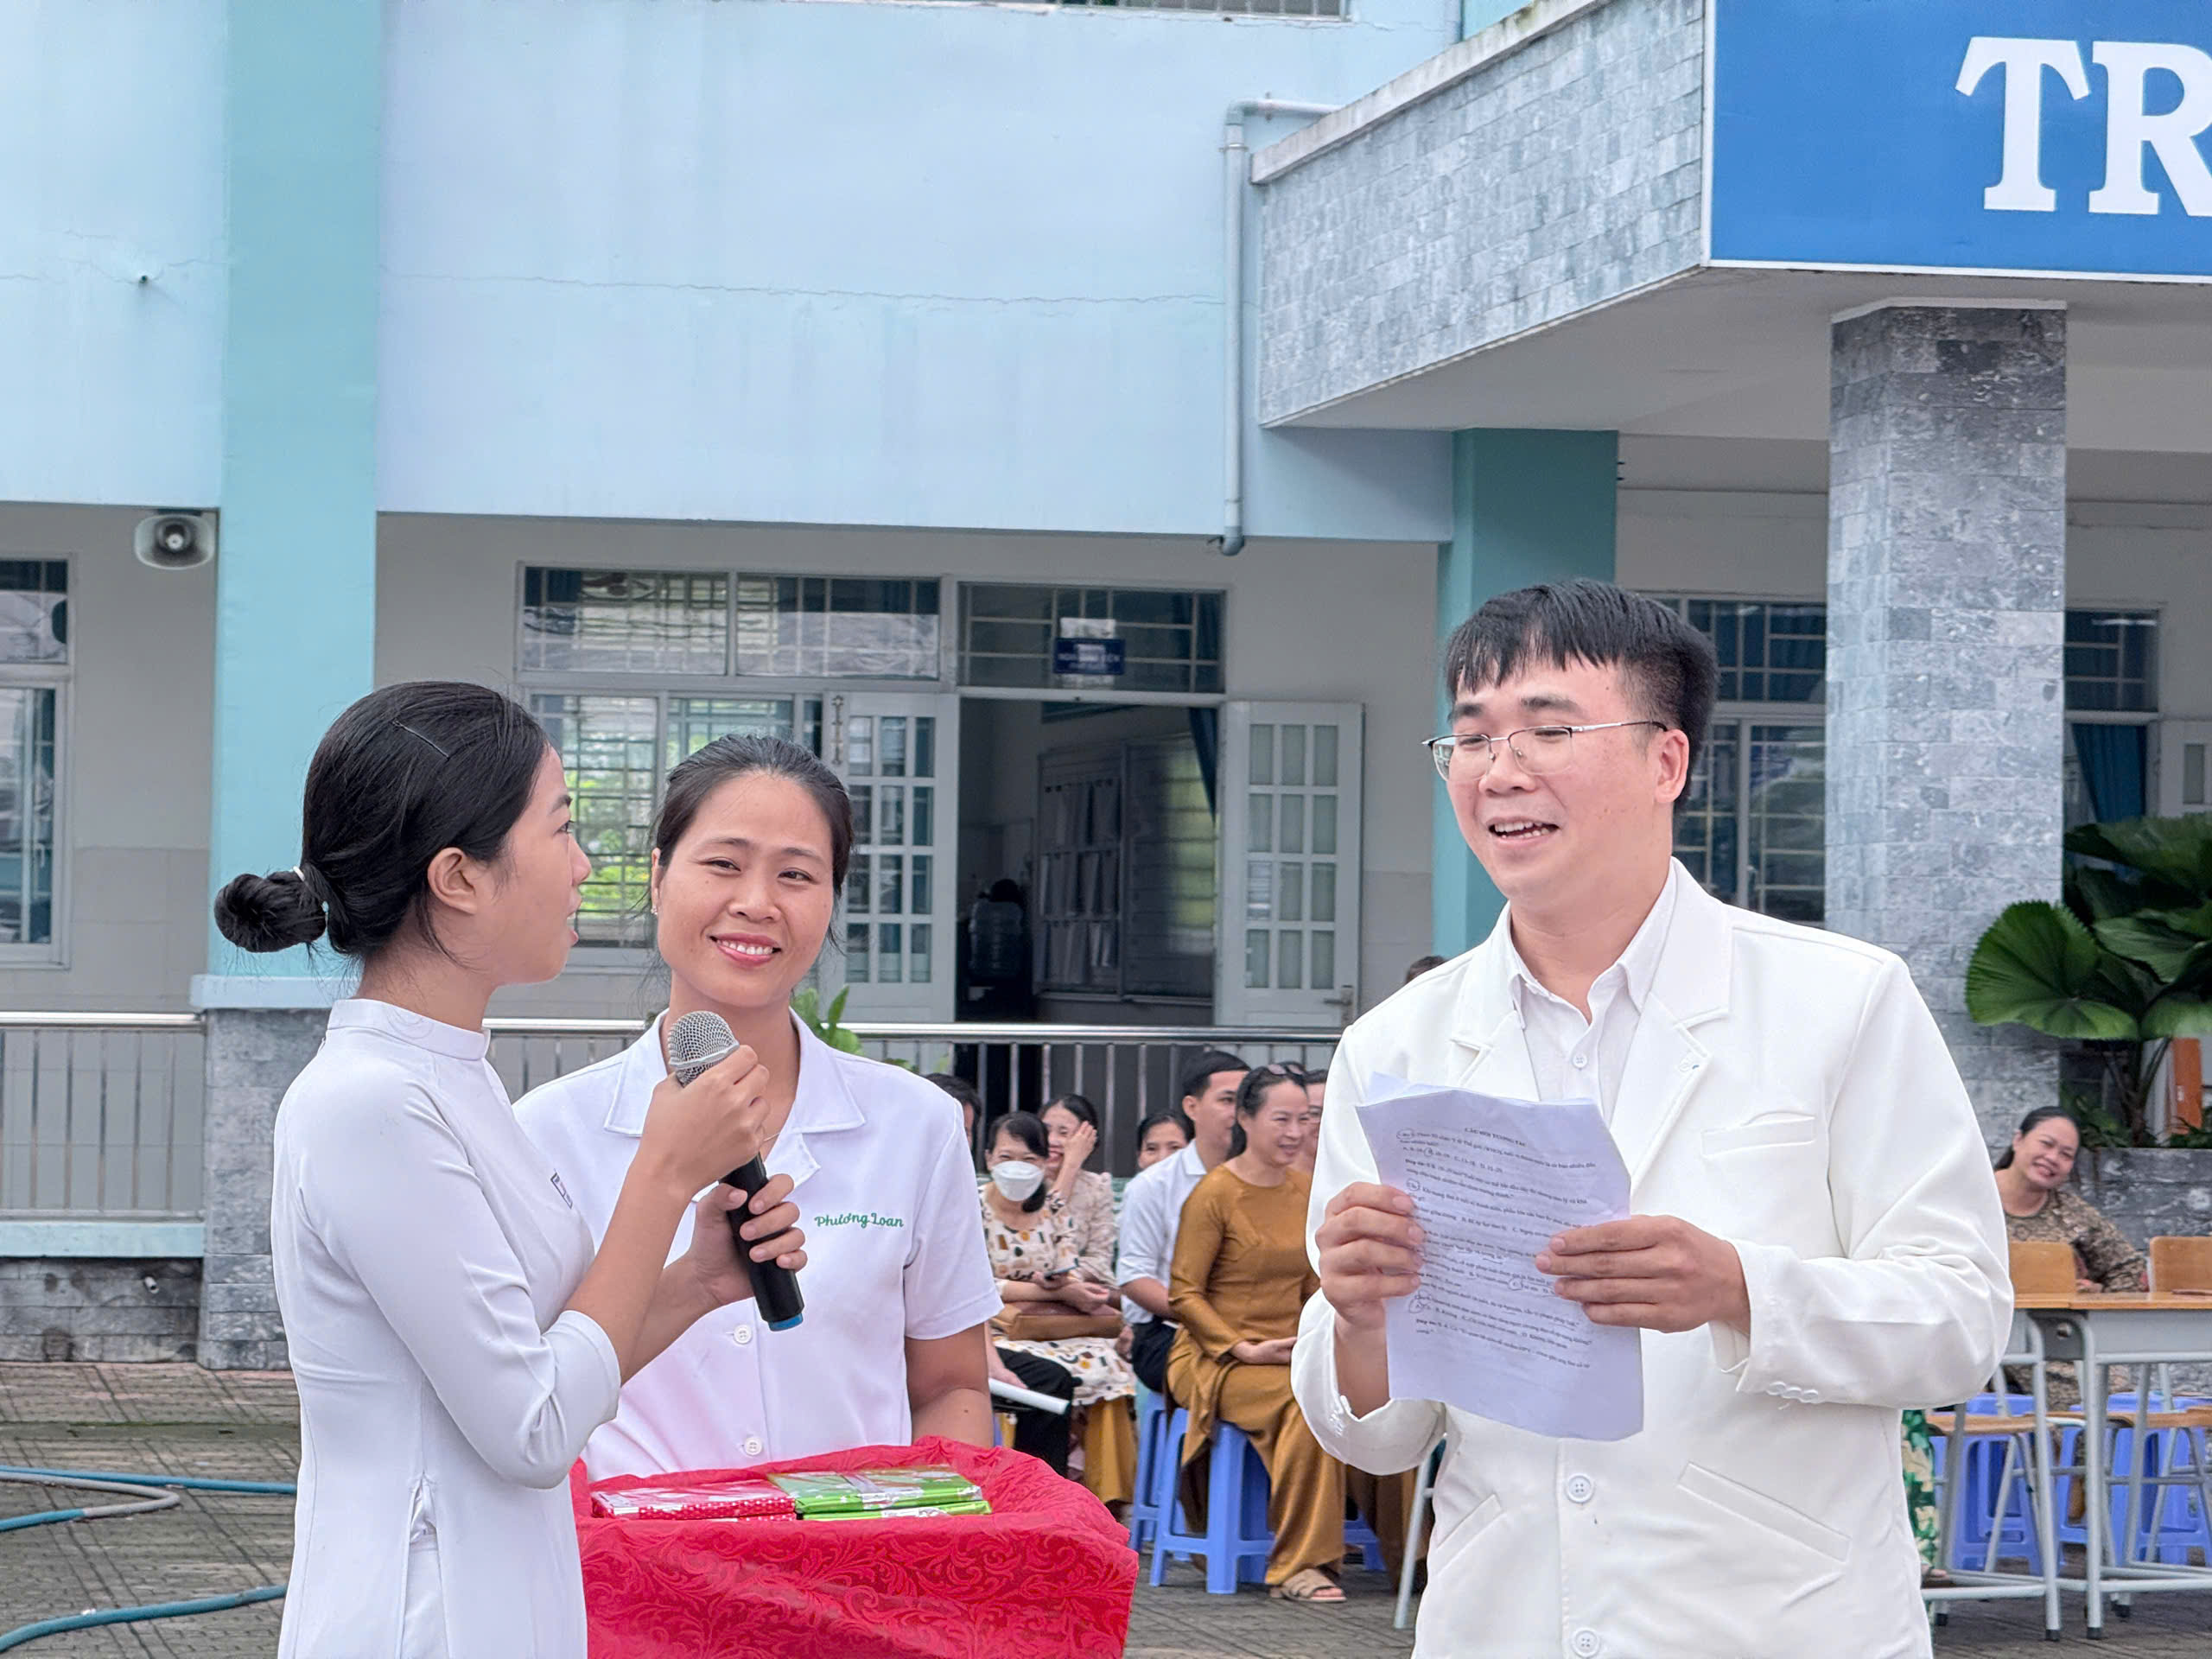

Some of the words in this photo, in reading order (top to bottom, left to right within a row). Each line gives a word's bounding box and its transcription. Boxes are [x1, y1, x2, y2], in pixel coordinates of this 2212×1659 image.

[1955, 36, 2212, 217] TR
[814, 1212, 869, 1229] Phương
[870, 1212, 904, 1228] Loan
